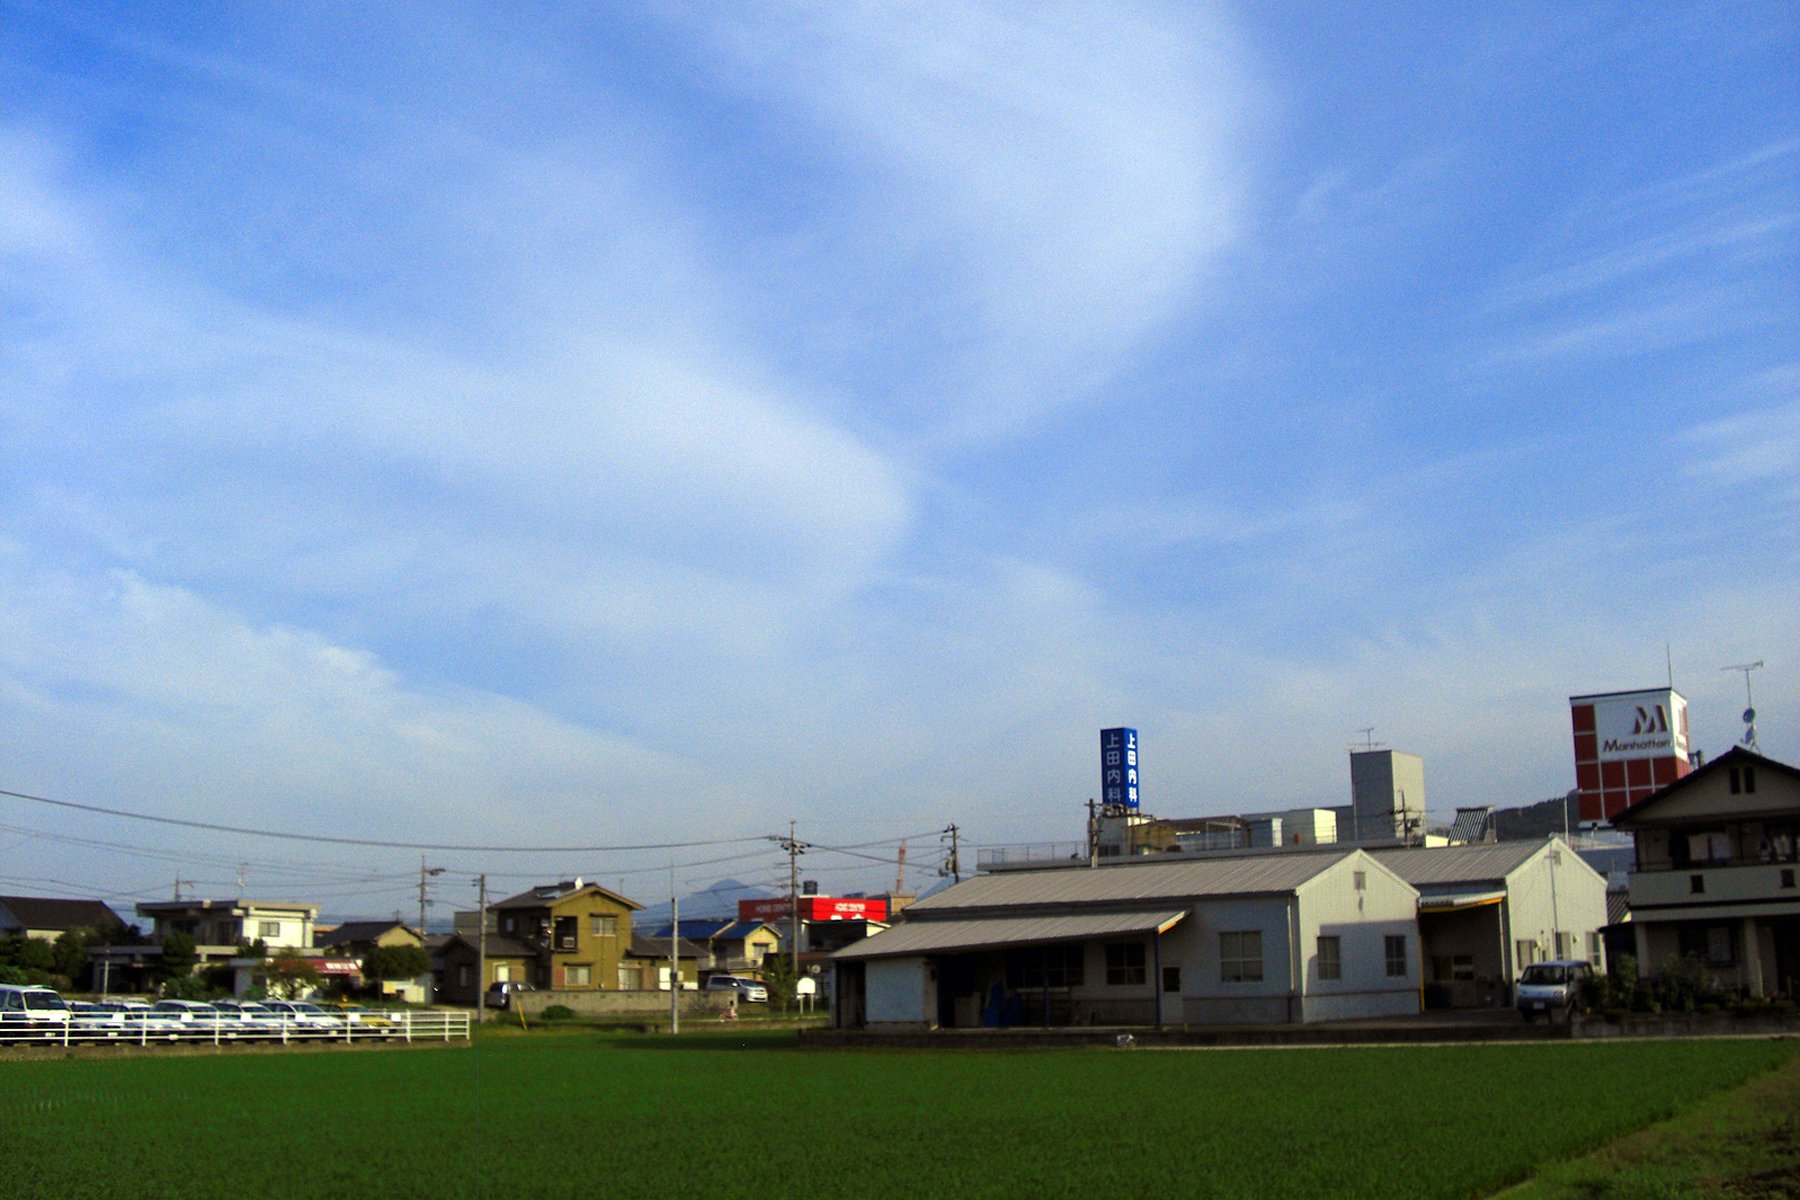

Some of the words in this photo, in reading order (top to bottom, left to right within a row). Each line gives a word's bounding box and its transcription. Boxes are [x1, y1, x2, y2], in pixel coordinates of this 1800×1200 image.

[1106, 733, 1121, 802] 上田内科
[1127, 732, 1138, 803] 上田内科
[1603, 738, 1671, 752] Manhattan
